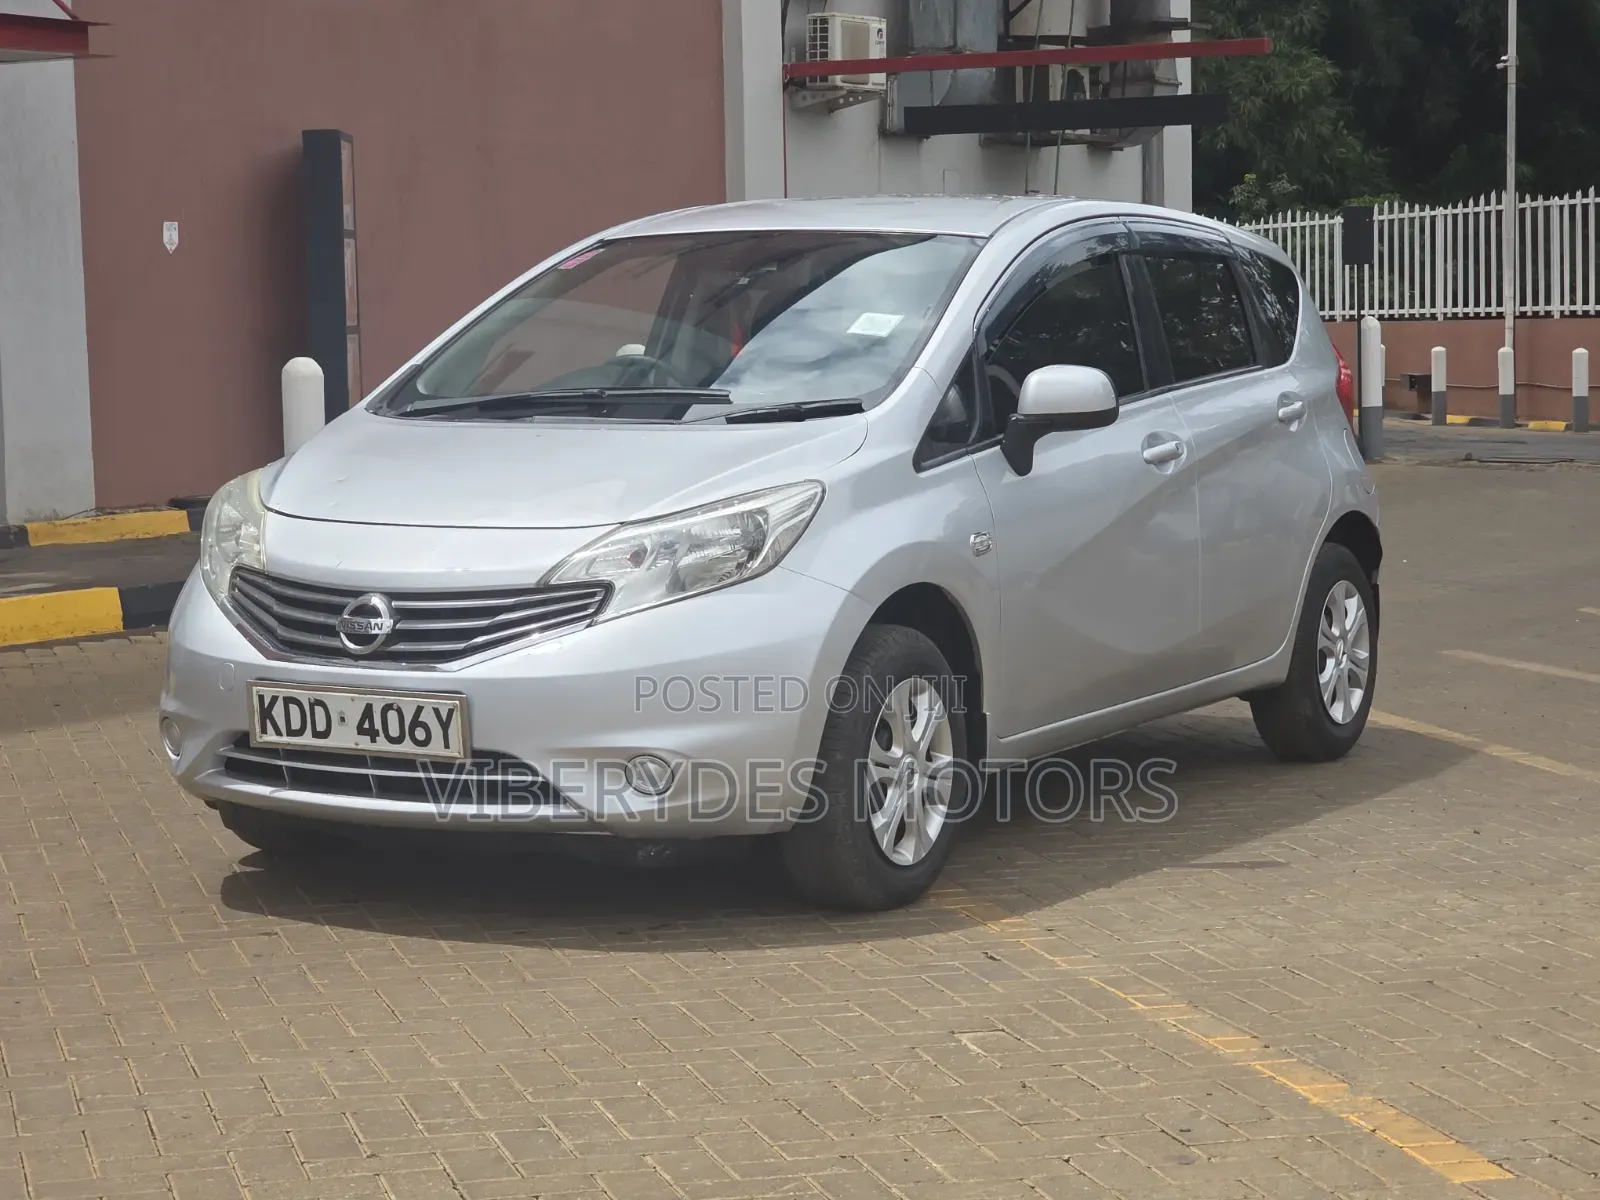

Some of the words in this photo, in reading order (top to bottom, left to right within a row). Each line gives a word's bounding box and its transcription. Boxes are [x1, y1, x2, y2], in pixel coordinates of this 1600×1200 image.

[340, 619, 384, 631] NISSAN
[257, 694, 332, 740] KDD
[356, 702, 455, 750] 406Y
